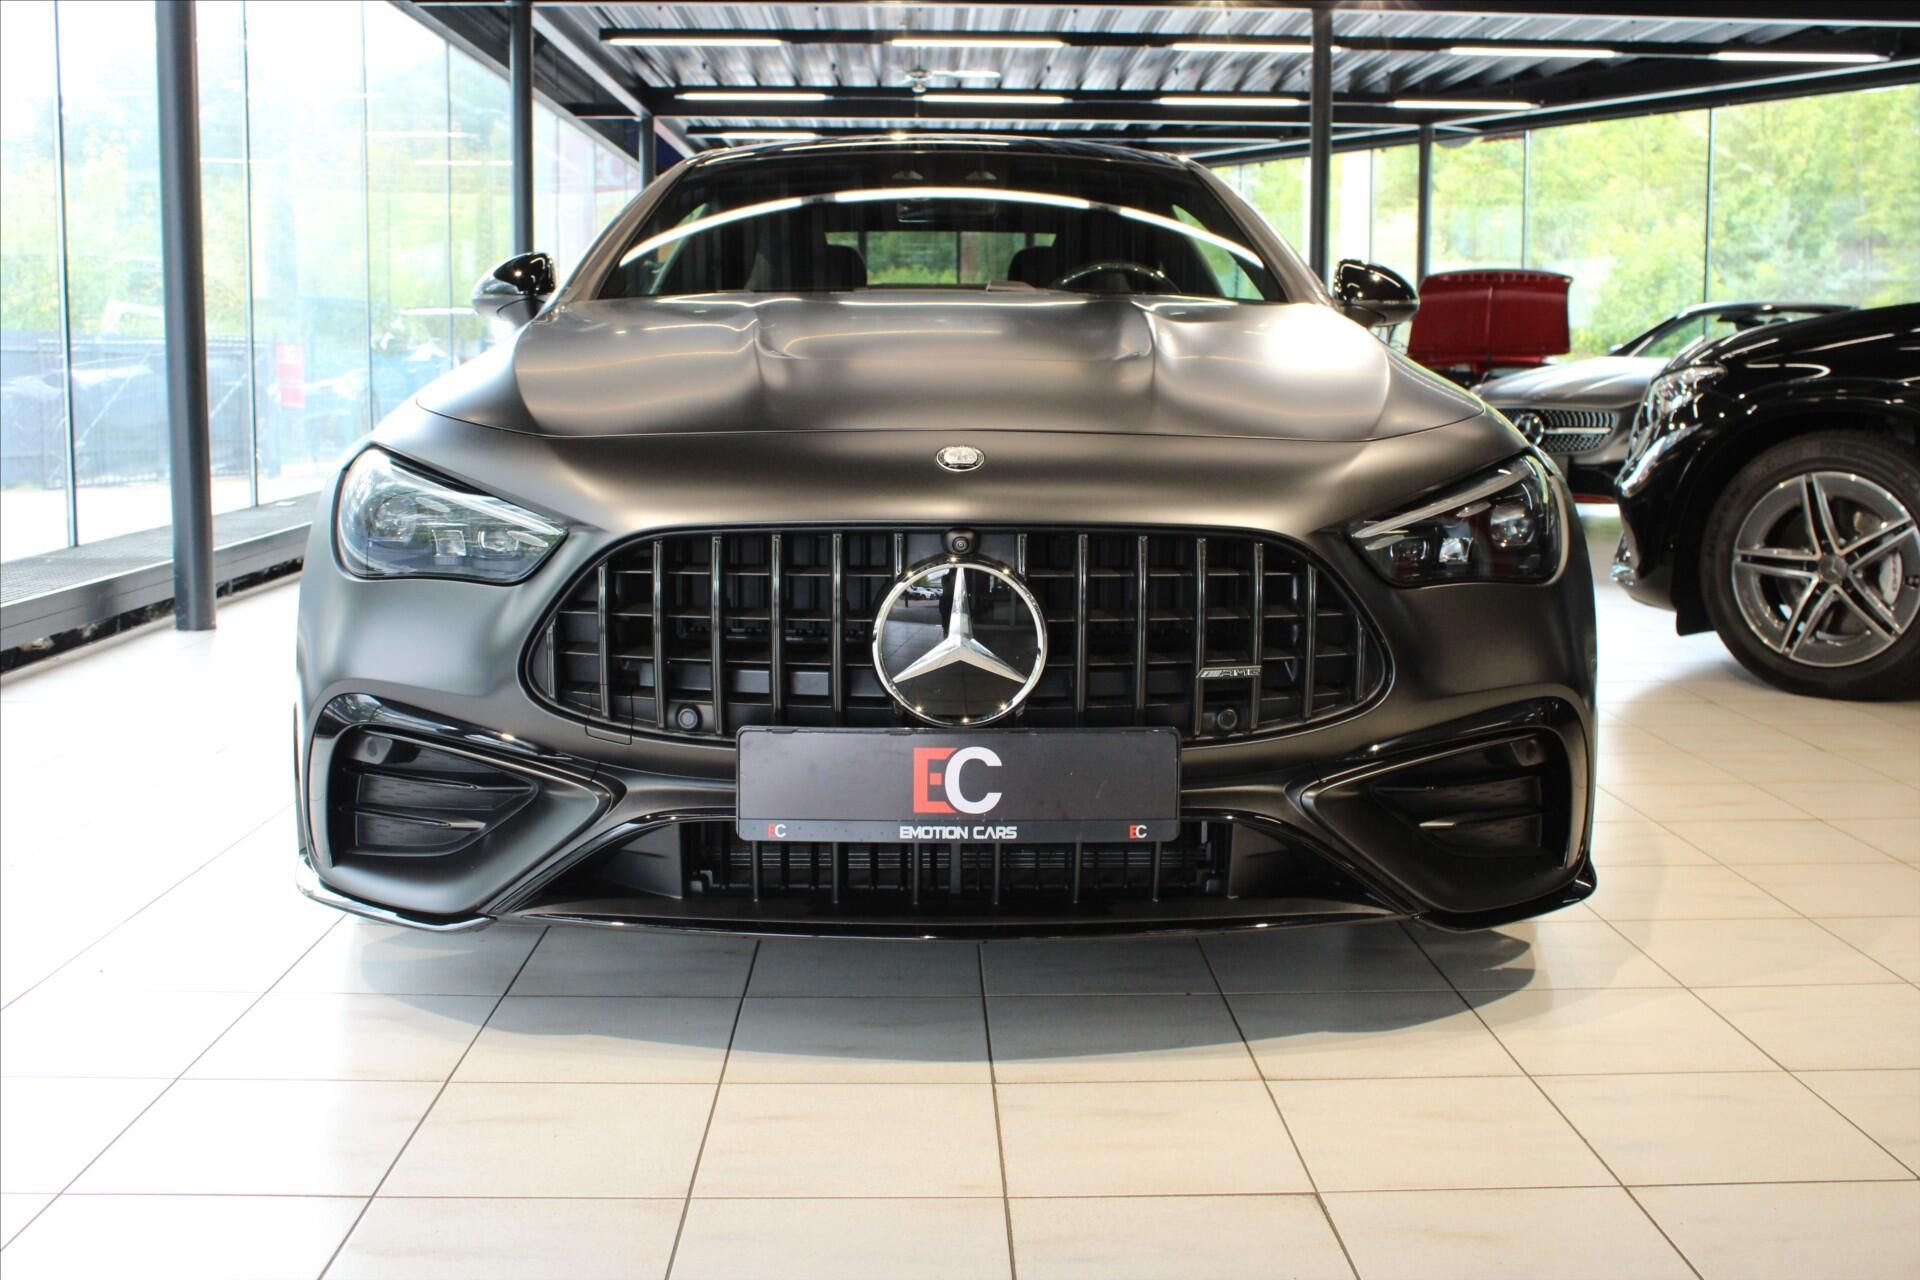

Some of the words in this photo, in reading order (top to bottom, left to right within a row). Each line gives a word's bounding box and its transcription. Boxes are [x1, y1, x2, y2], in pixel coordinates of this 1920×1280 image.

[1219, 667, 1261, 678] AMG
[913, 746, 1003, 815] EC
[899, 825, 969, 840] EMOTION
[972, 825, 1018, 840] CARS
[1129, 824, 1147, 839] EC
